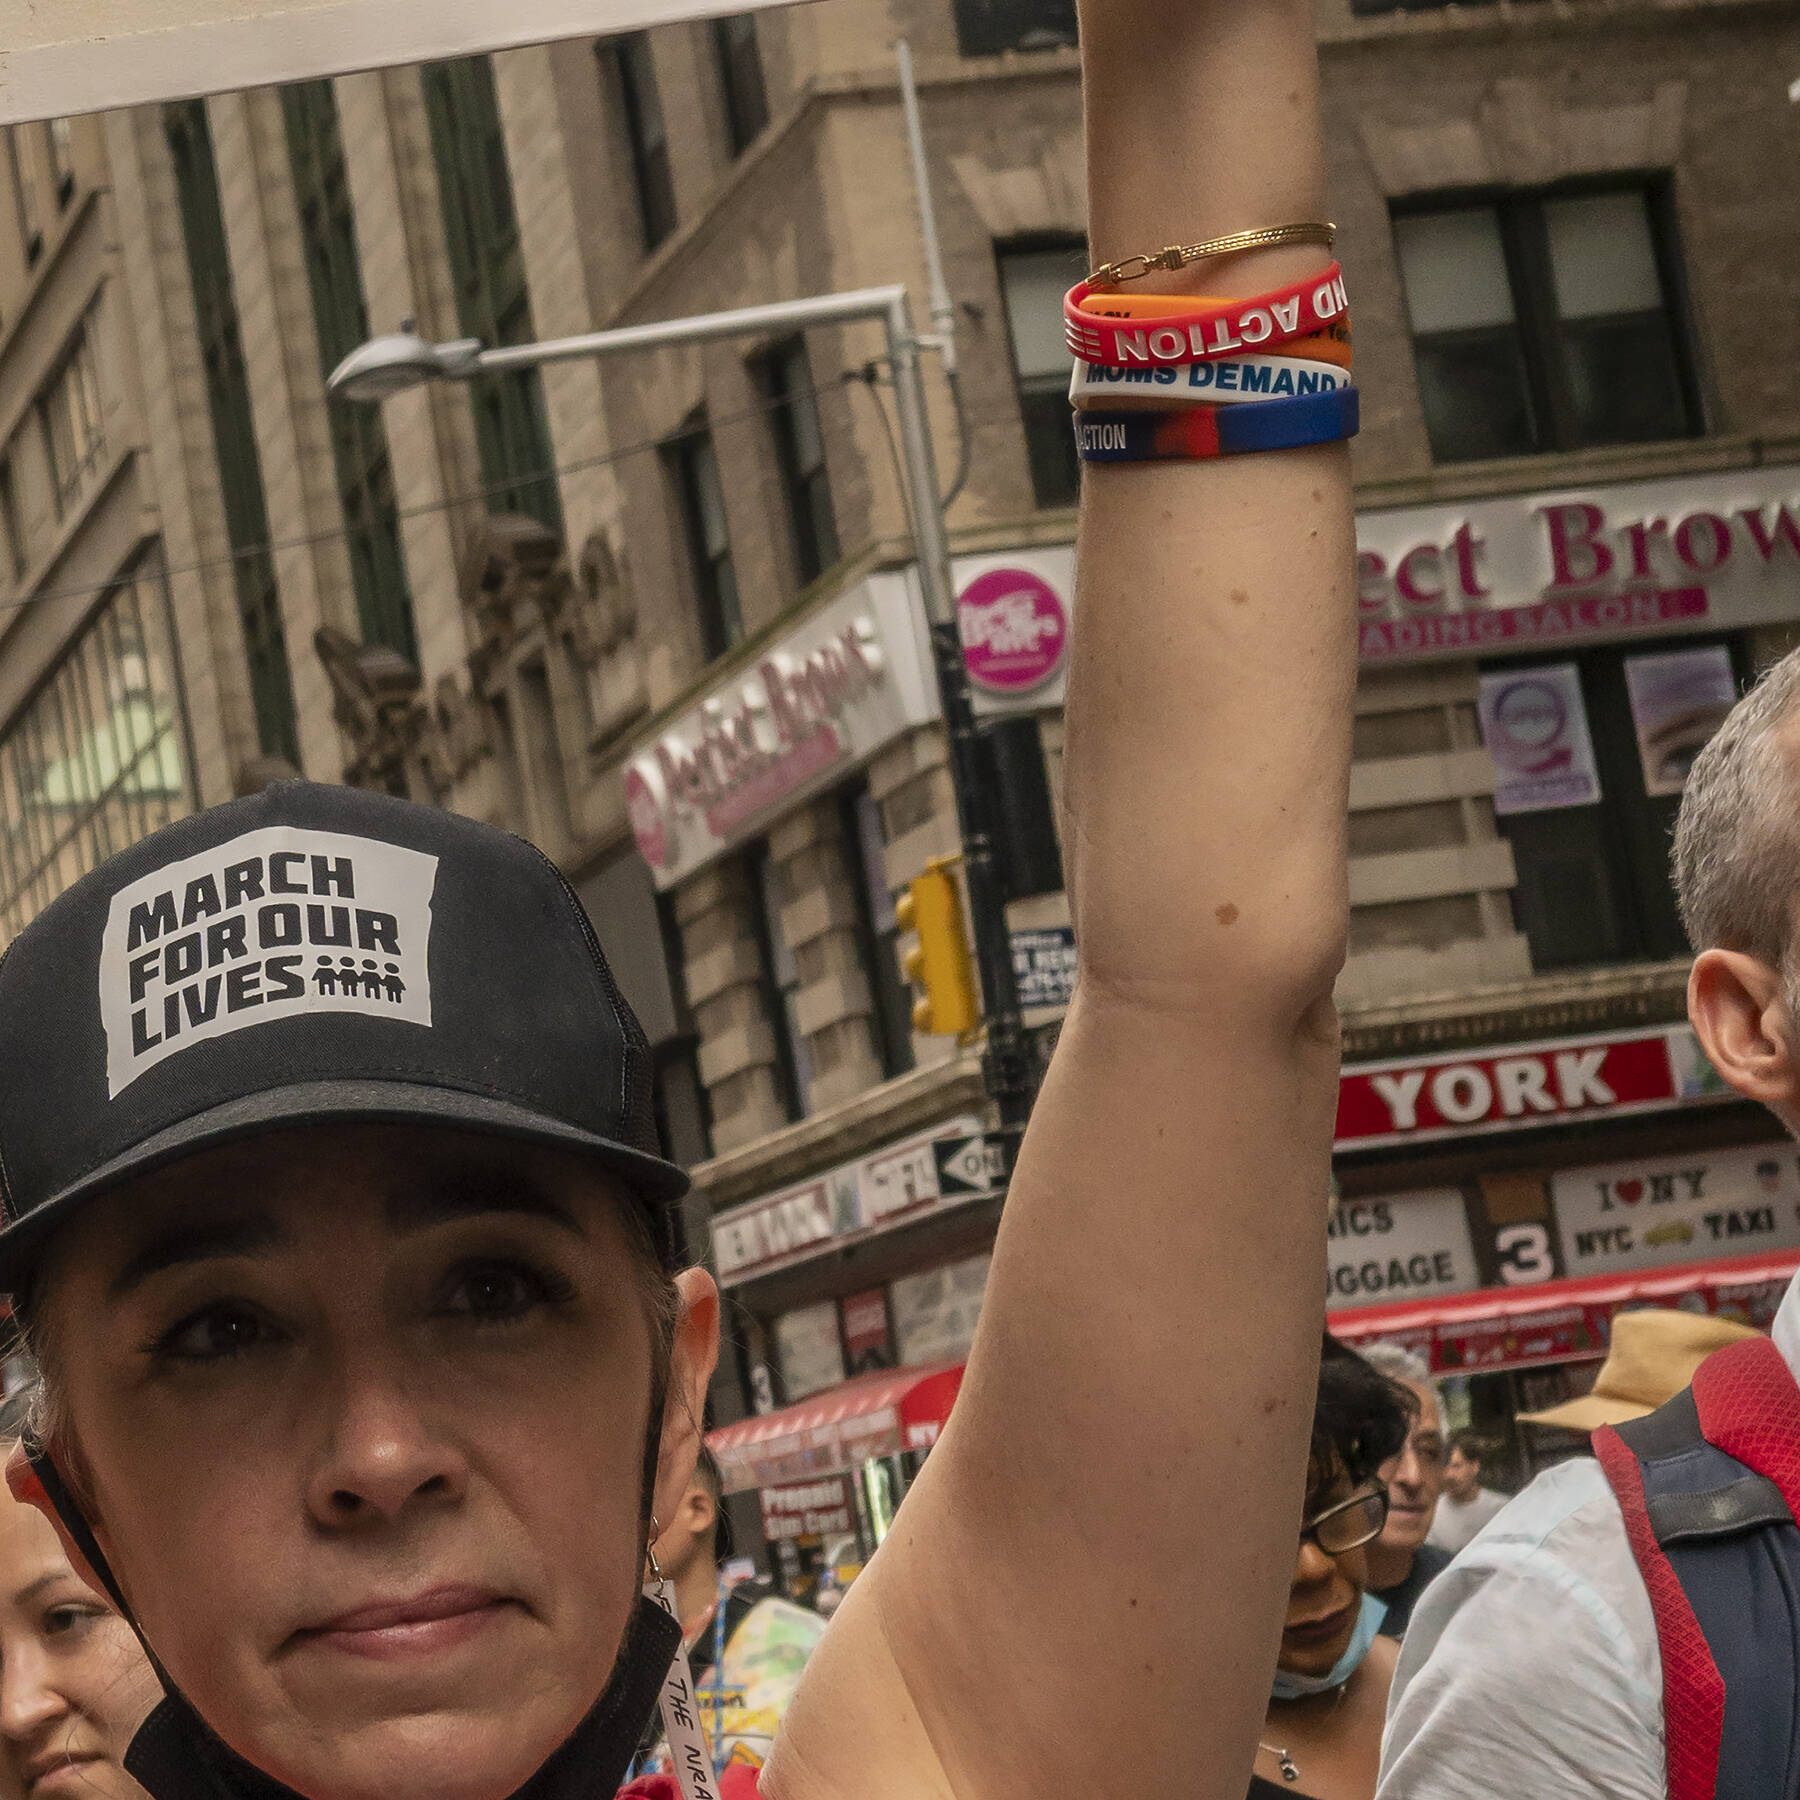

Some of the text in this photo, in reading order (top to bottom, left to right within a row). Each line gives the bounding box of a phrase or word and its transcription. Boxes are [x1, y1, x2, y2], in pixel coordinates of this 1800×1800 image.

[1113, 293, 1301, 361] ACTION
[1086, 360, 1338, 397] MOMS DEMAND
[126, 851, 356, 953] MARCH
[129, 902, 403, 1005] FOR OUR
[131, 954, 306, 1059] LIVES
[1369, 1046, 1617, 1130] YORK
[1496, 1223, 1555, 1286] 3
[1575, 1206, 1776, 1257] NYC TAXI
[668, 1677, 694, 1731] THE
